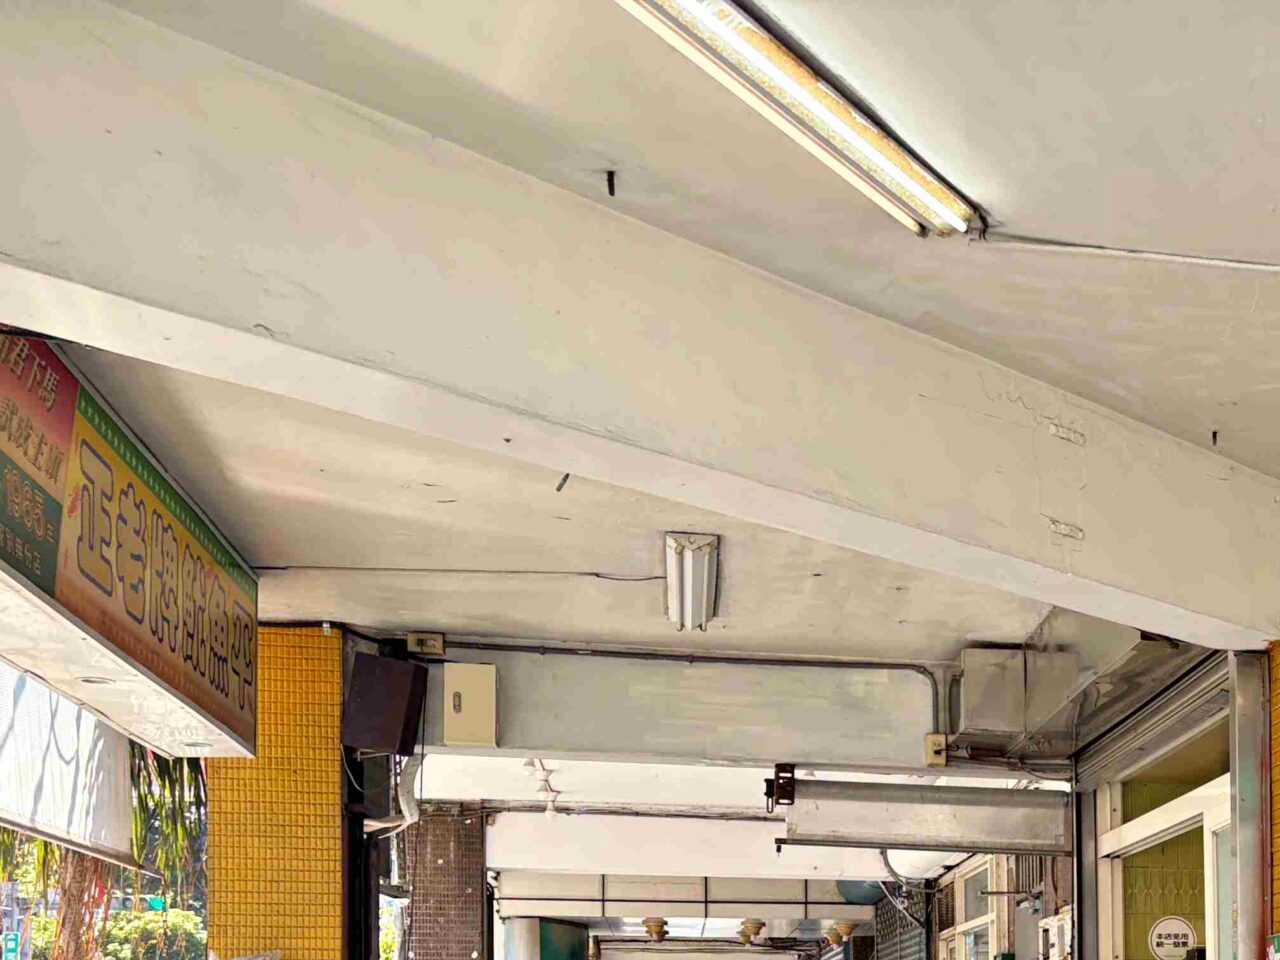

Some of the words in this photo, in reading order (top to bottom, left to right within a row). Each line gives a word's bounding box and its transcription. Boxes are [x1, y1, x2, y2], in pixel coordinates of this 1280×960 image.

[77, 438, 253, 711] 正老牌魷魚平
